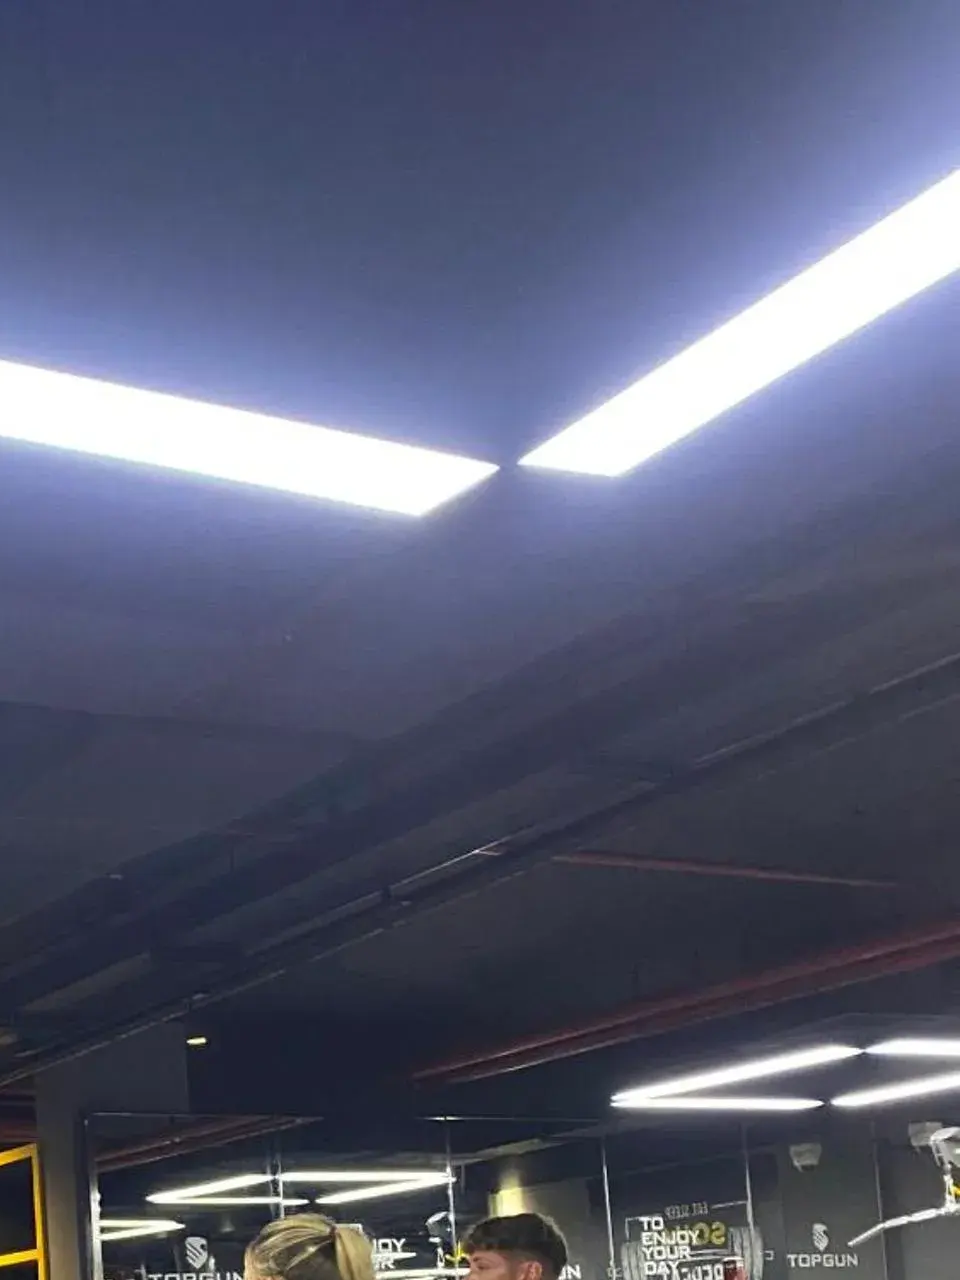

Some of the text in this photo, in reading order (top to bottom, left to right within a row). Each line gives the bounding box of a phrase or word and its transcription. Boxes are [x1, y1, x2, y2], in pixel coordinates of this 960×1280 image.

[640, 1216, 665, 1231] TO
[641, 1230, 700, 1246] ENJOY
[641, 1245, 691, 1261] YOUR
[786, 1253, 859, 1268] TOPGUN
[644, 1260, 680, 1276] DAY
